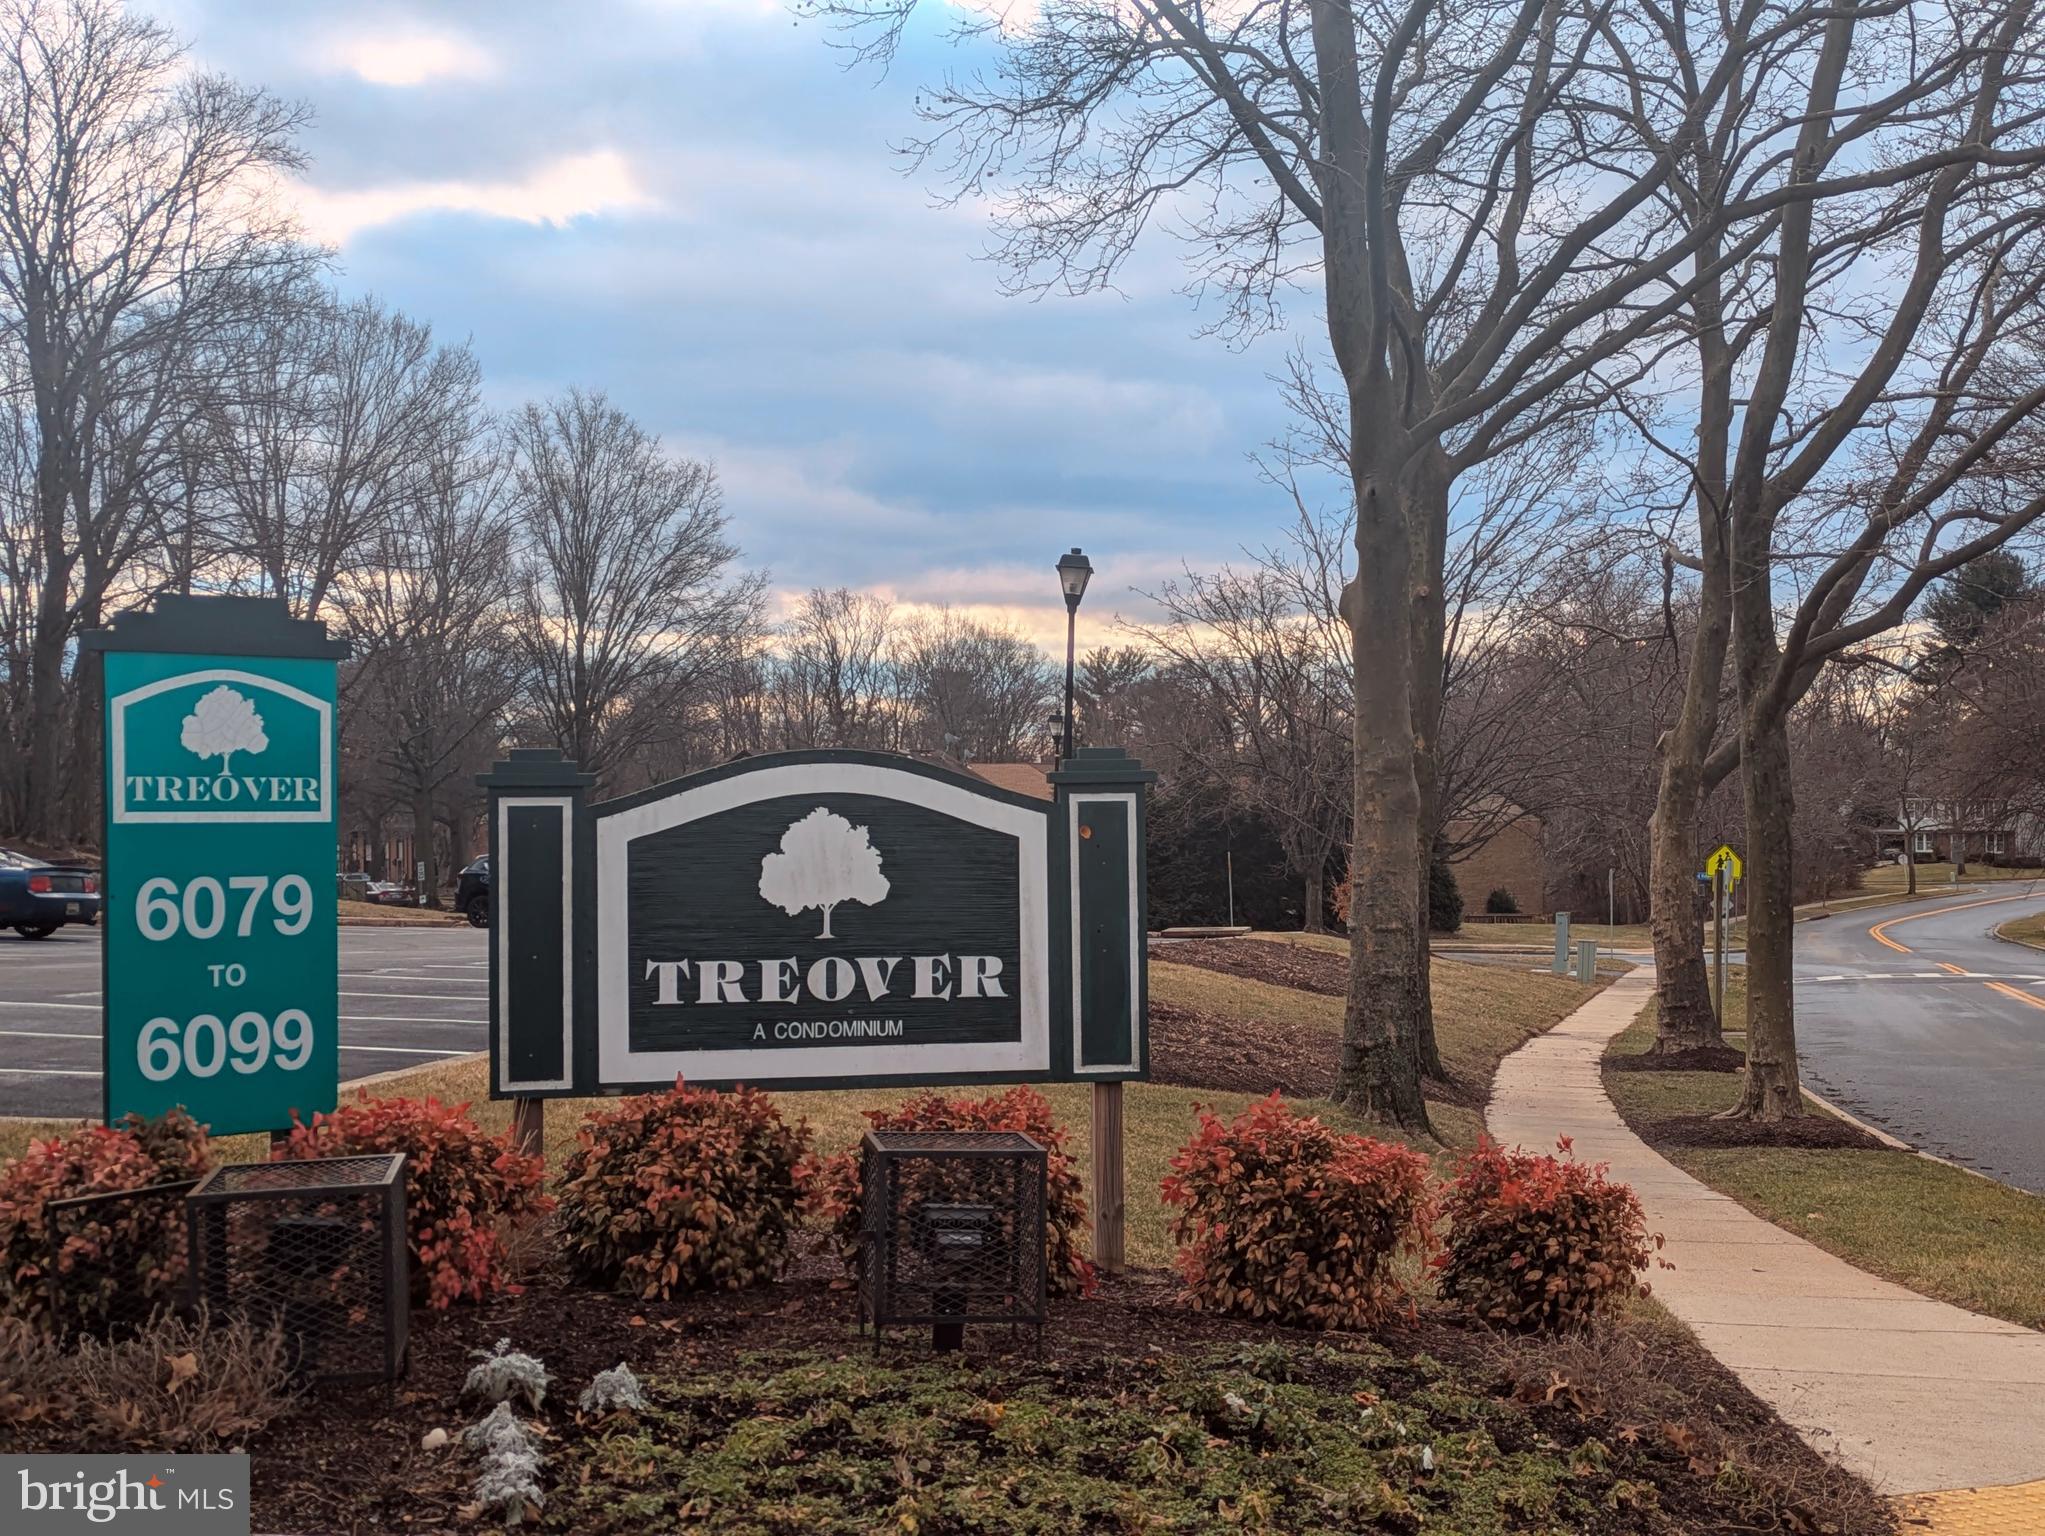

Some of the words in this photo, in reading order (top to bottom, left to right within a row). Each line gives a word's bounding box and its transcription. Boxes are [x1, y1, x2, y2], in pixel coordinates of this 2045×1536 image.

[126, 774, 319, 803] TREOVER
[135, 874, 313, 942] 6079
[207, 963, 247, 988] TO
[645, 952, 1009, 1005] TREOVER
[136, 1008, 314, 1082] 6099
[753, 1022, 766, 1040] A
[774, 1019, 903, 1040] CONDOMINIUM
